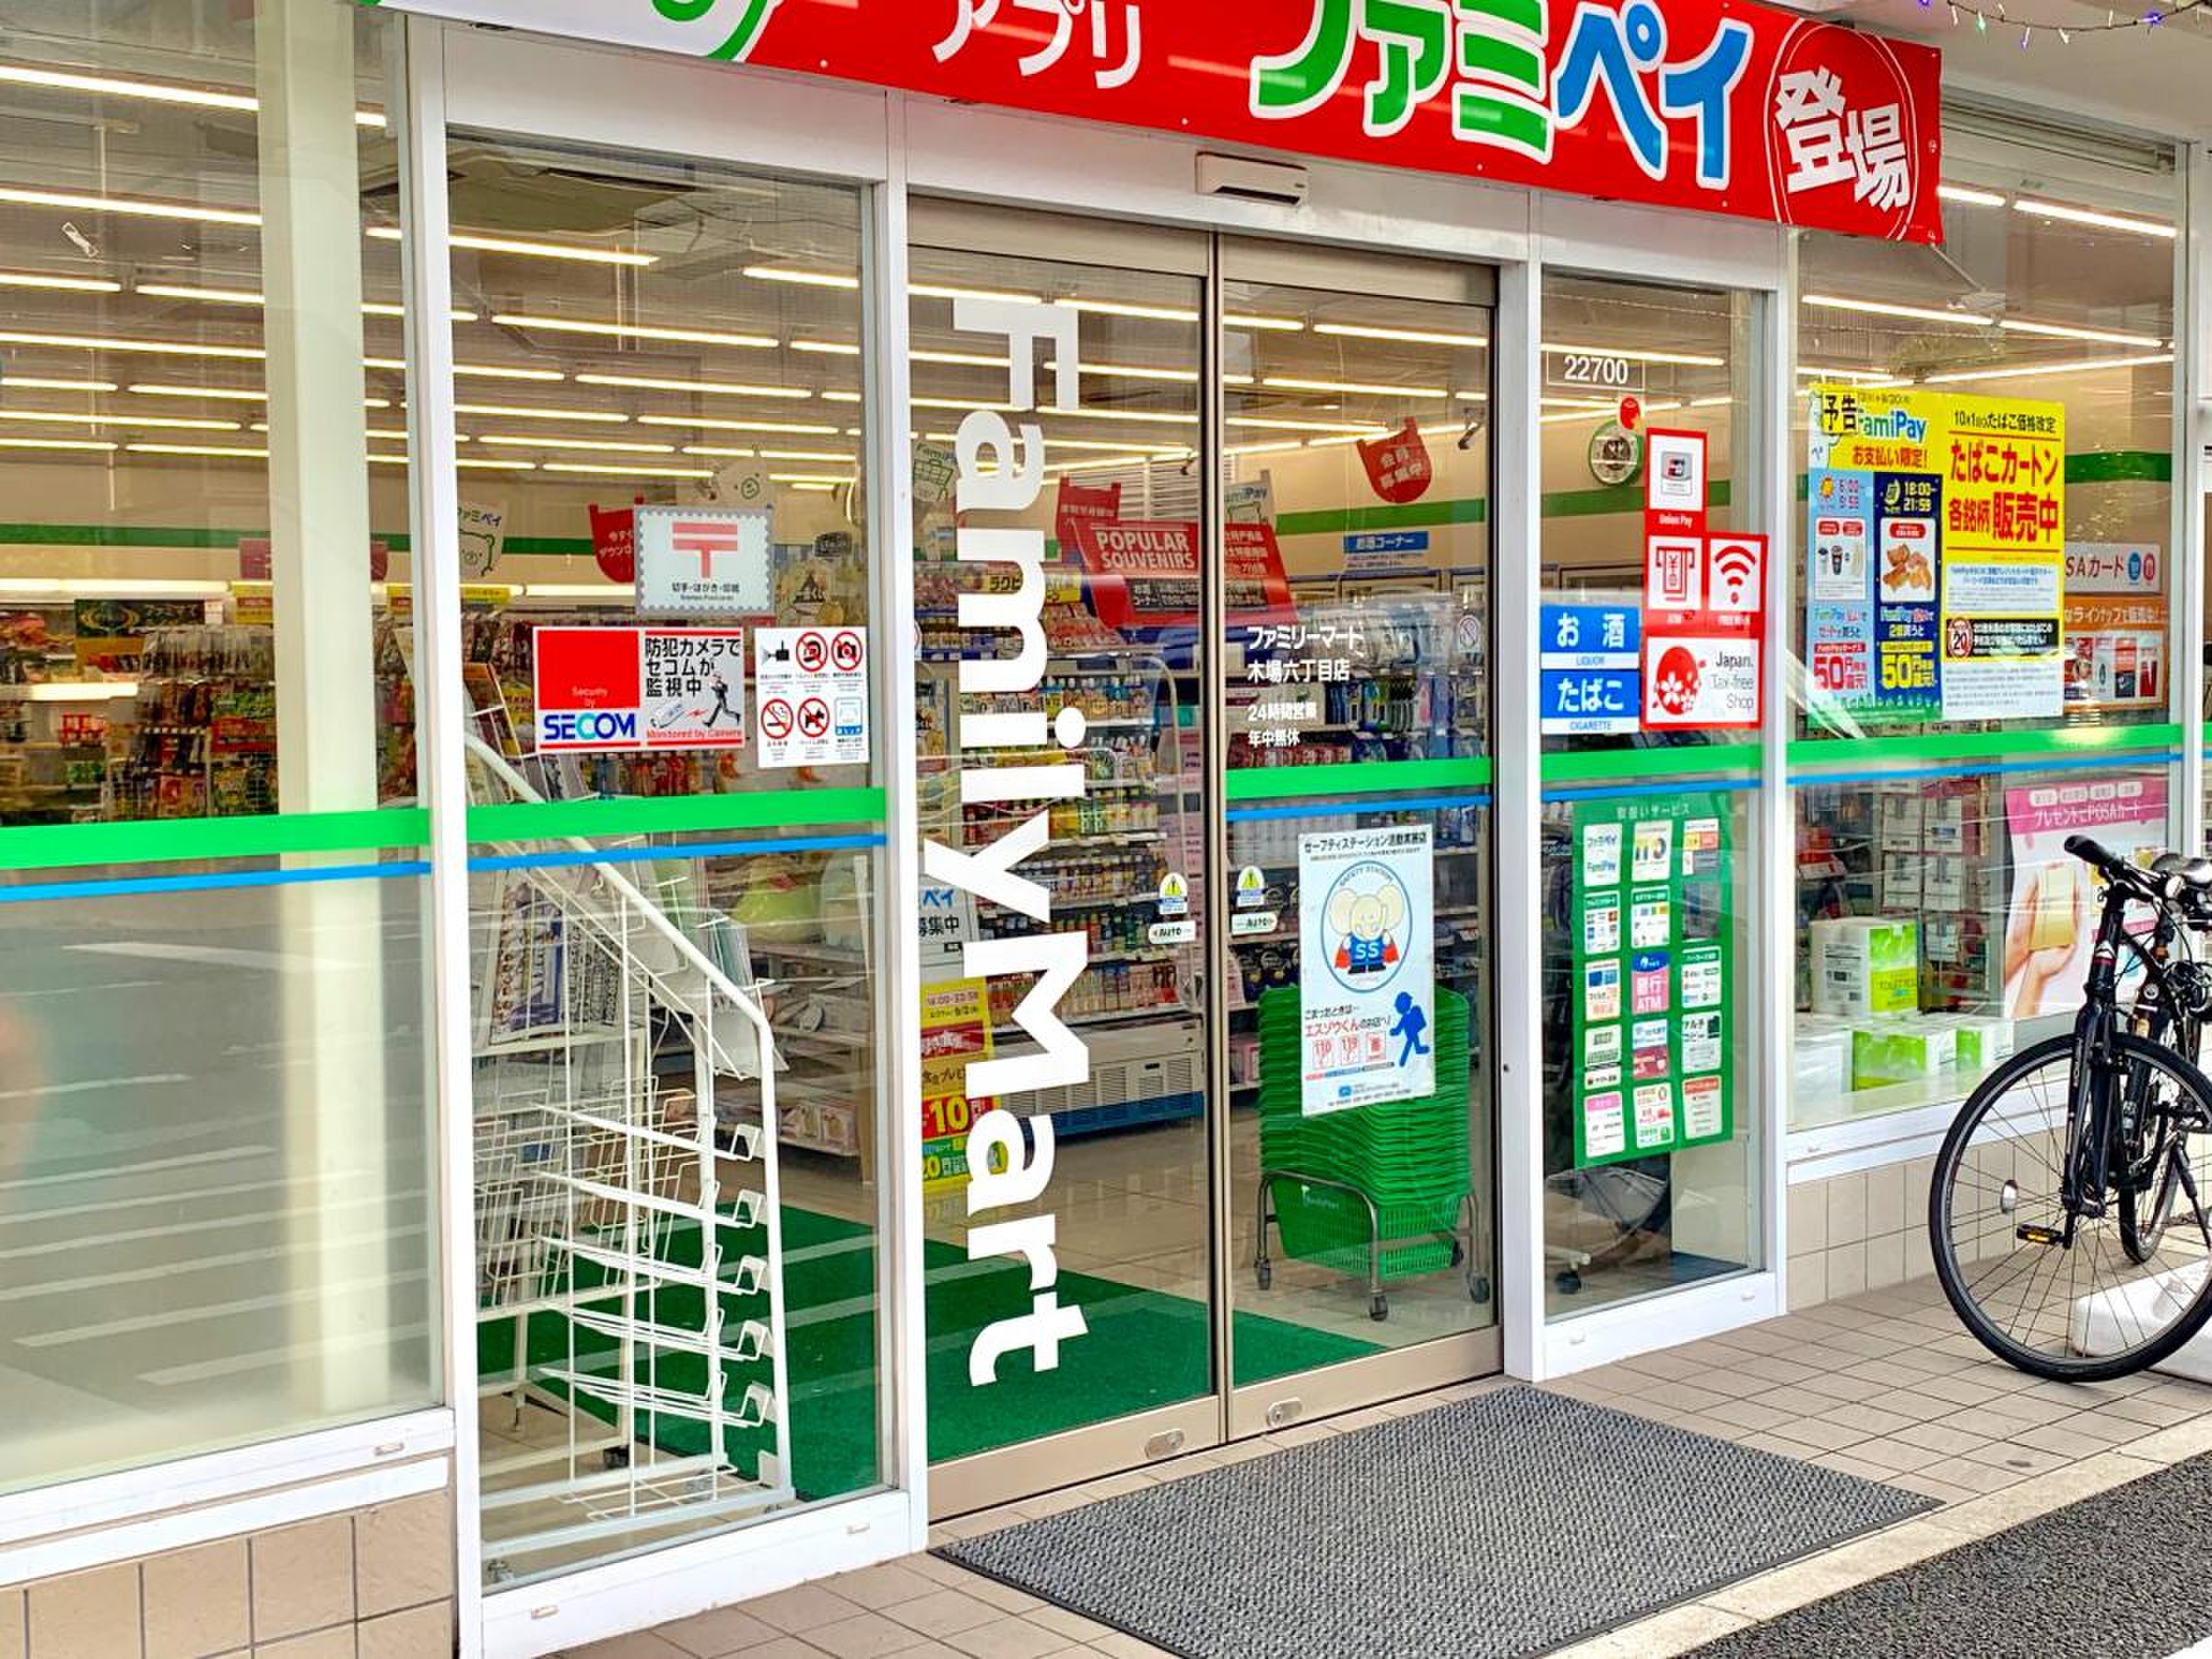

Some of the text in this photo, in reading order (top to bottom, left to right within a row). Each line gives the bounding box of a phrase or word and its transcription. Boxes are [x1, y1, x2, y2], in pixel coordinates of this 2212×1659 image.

[1249, 0, 1755, 190] ファミペイ
[1774, 64, 1912, 213] 登場
[1563, 354, 1629, 383] 22700
[1823, 394, 1857, 431] 予告
[1950, 440, 2059, 487] たばこカートン
[1993, 491, 2059, 542] 販売中
[1096, 531, 1190, 552] POPULAR
[1100, 552, 1196, 570] SOUVENIRS
[645, 637, 741, 658] 防犯カメラで
[1246, 625, 1365, 650] ファミリーマート
[1247, 658, 1351, 683] 木場六丁目店
[645, 677, 702, 698] 監視中
[1557, 677, 1624, 712] たばこ
[1725, 694, 1755, 710] Shop
[543, 712, 637, 740] SECOM
[924, 296, 1090, 1387] FamilyMart
[1356, 943, 1380, 959] SS
